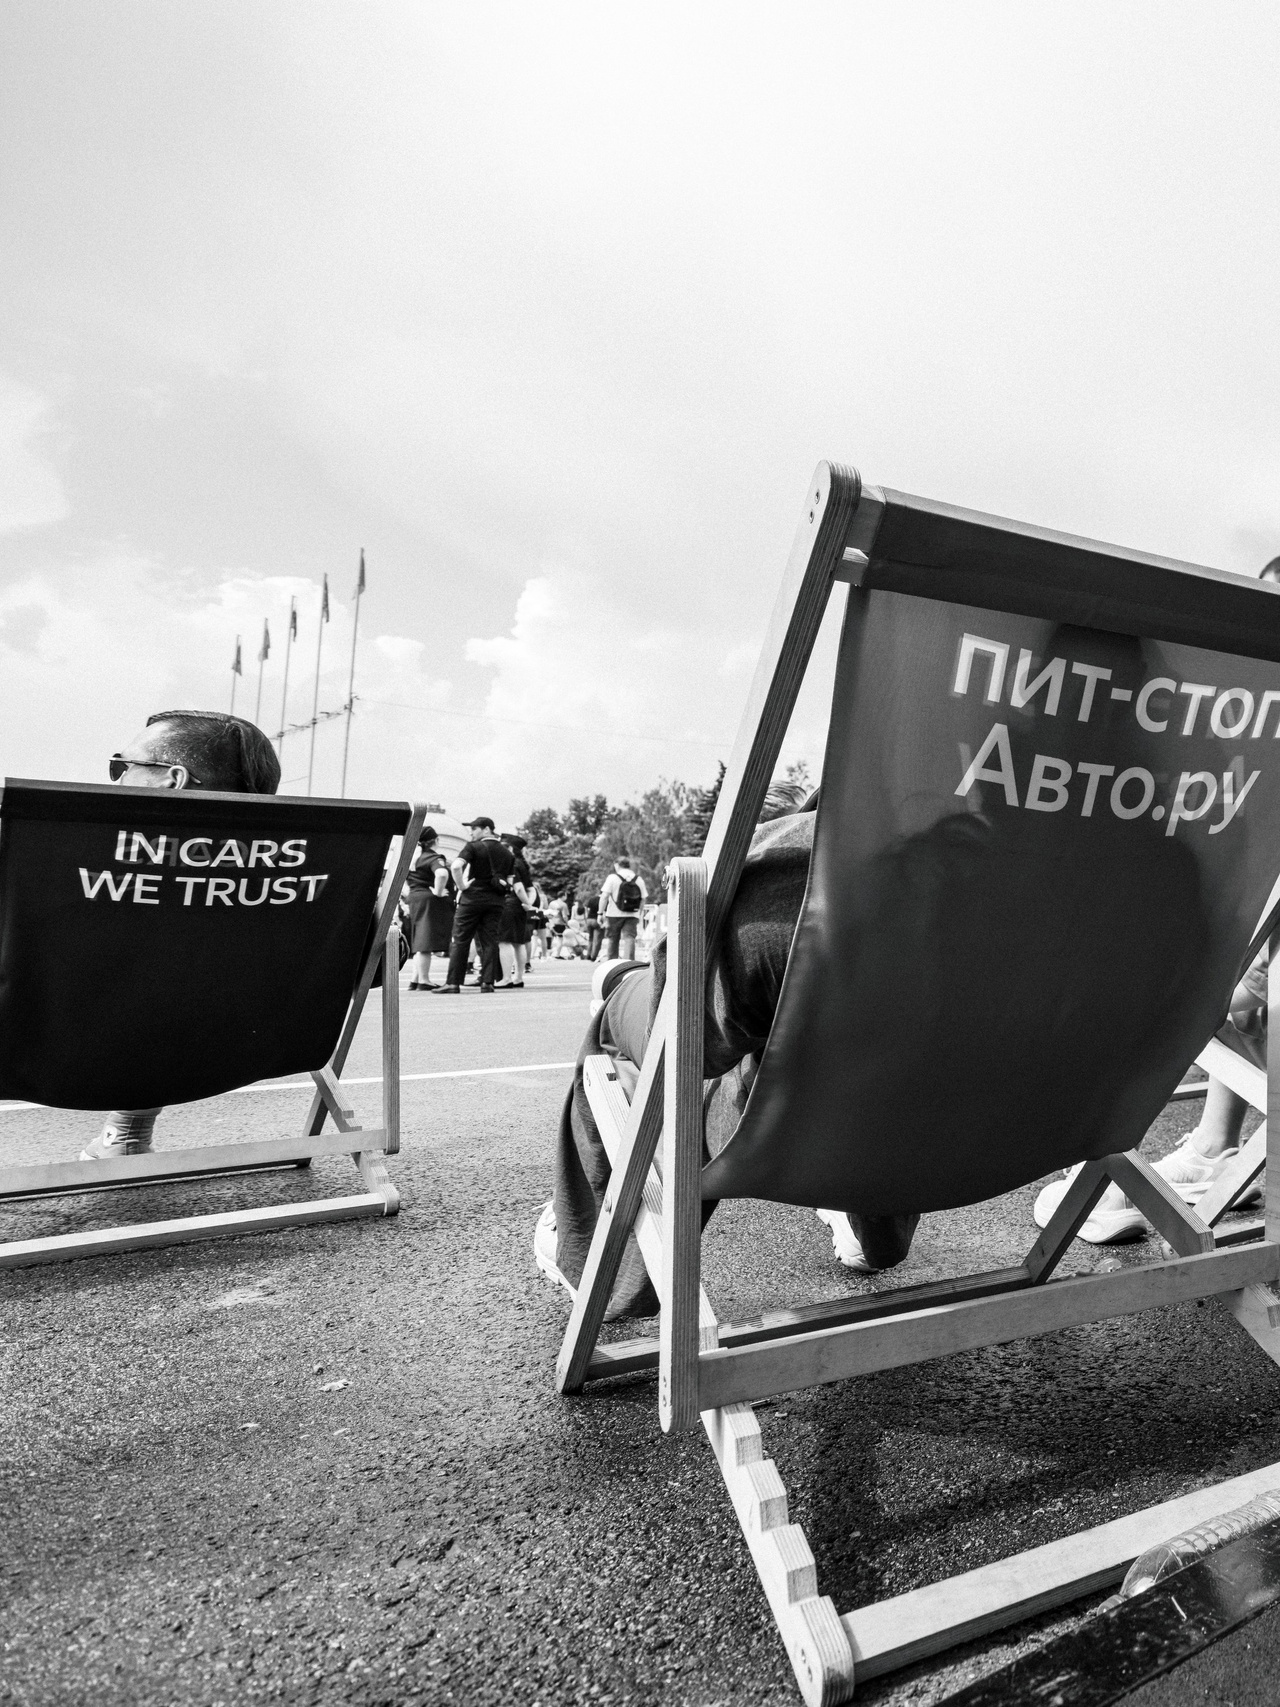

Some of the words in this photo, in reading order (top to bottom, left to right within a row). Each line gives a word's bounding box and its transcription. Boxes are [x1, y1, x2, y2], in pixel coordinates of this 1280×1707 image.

[954, 722, 1261, 836] Авто.ру
[114, 830, 167, 865] IN
[179, 837, 308, 868] CARS
[78, 867, 163, 905] WE
[175, 873, 329, 906] TRUST
